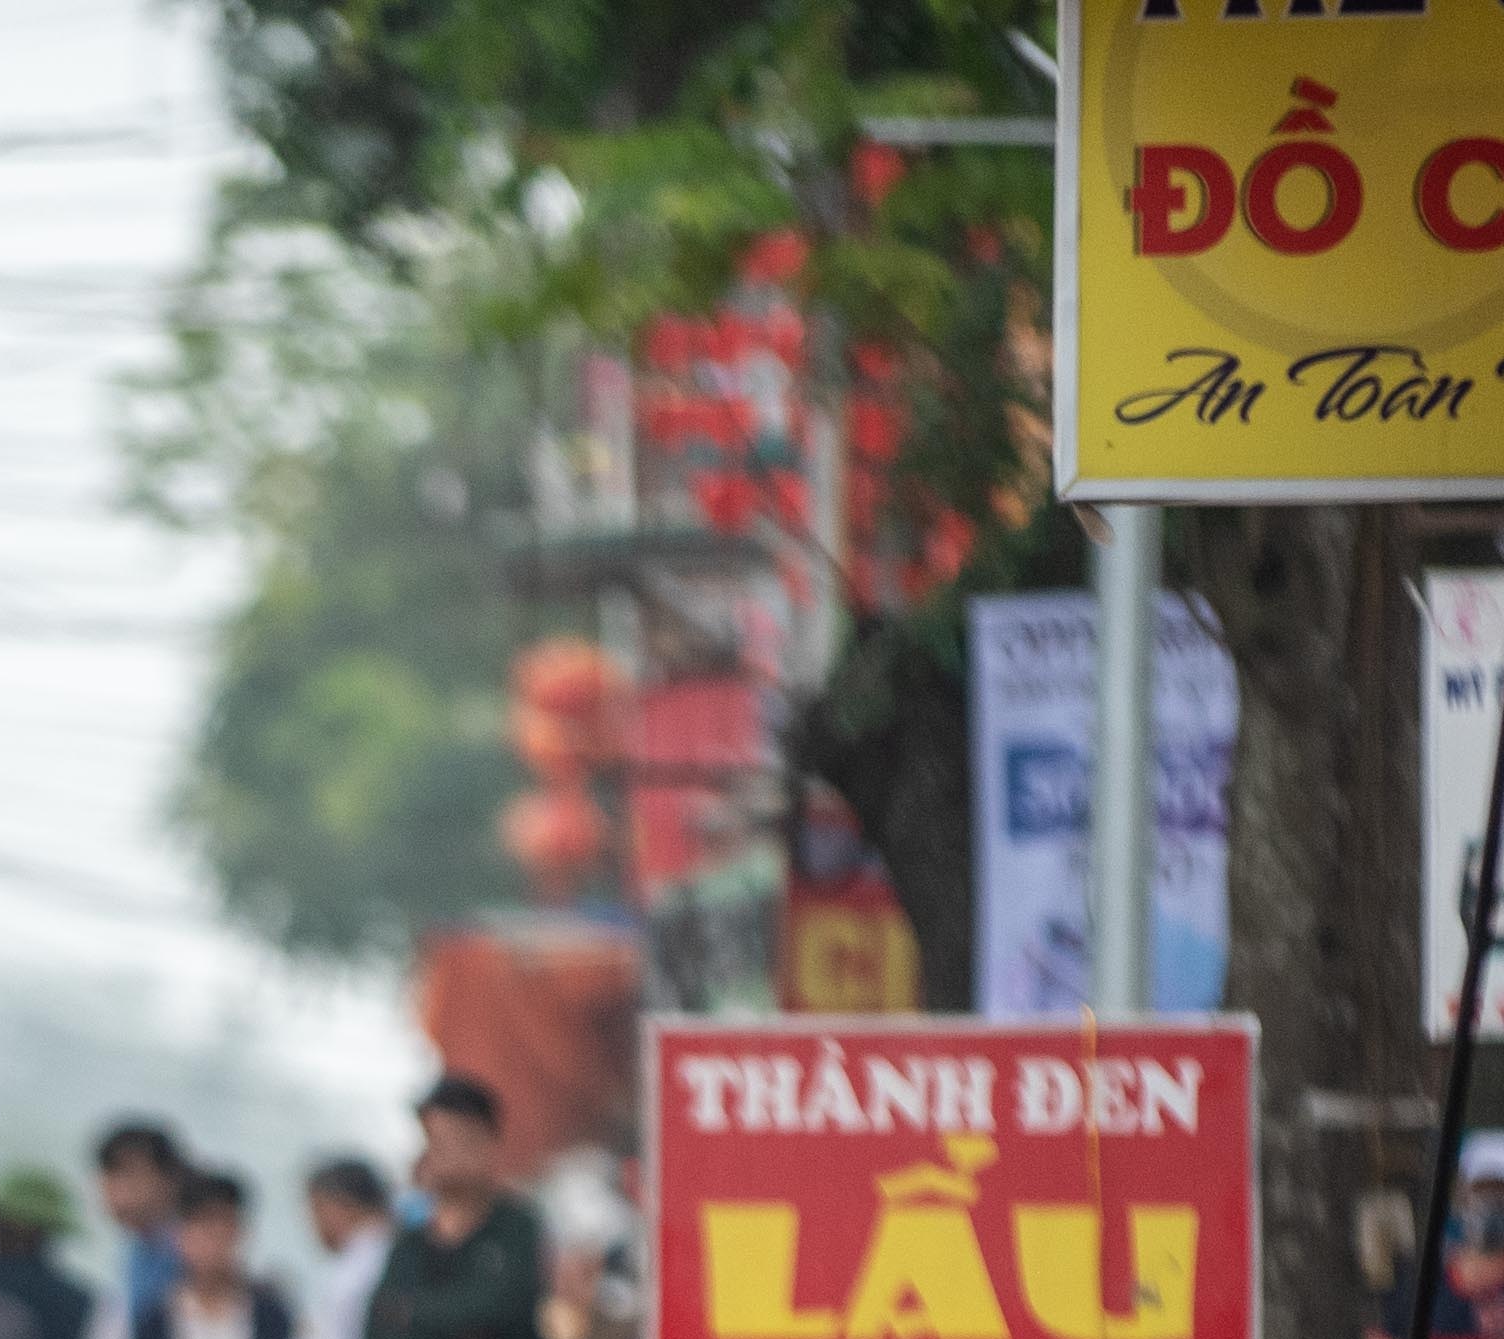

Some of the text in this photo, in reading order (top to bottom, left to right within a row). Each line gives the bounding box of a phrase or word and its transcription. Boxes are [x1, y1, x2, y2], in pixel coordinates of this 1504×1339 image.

[1125, 76, 1365, 258] ĐỒ
[1114, 345, 1268, 424] An
[1287, 343, 1477, 423] Toàn
[677, 1040, 1203, 1136] THÀNH ĐEN
